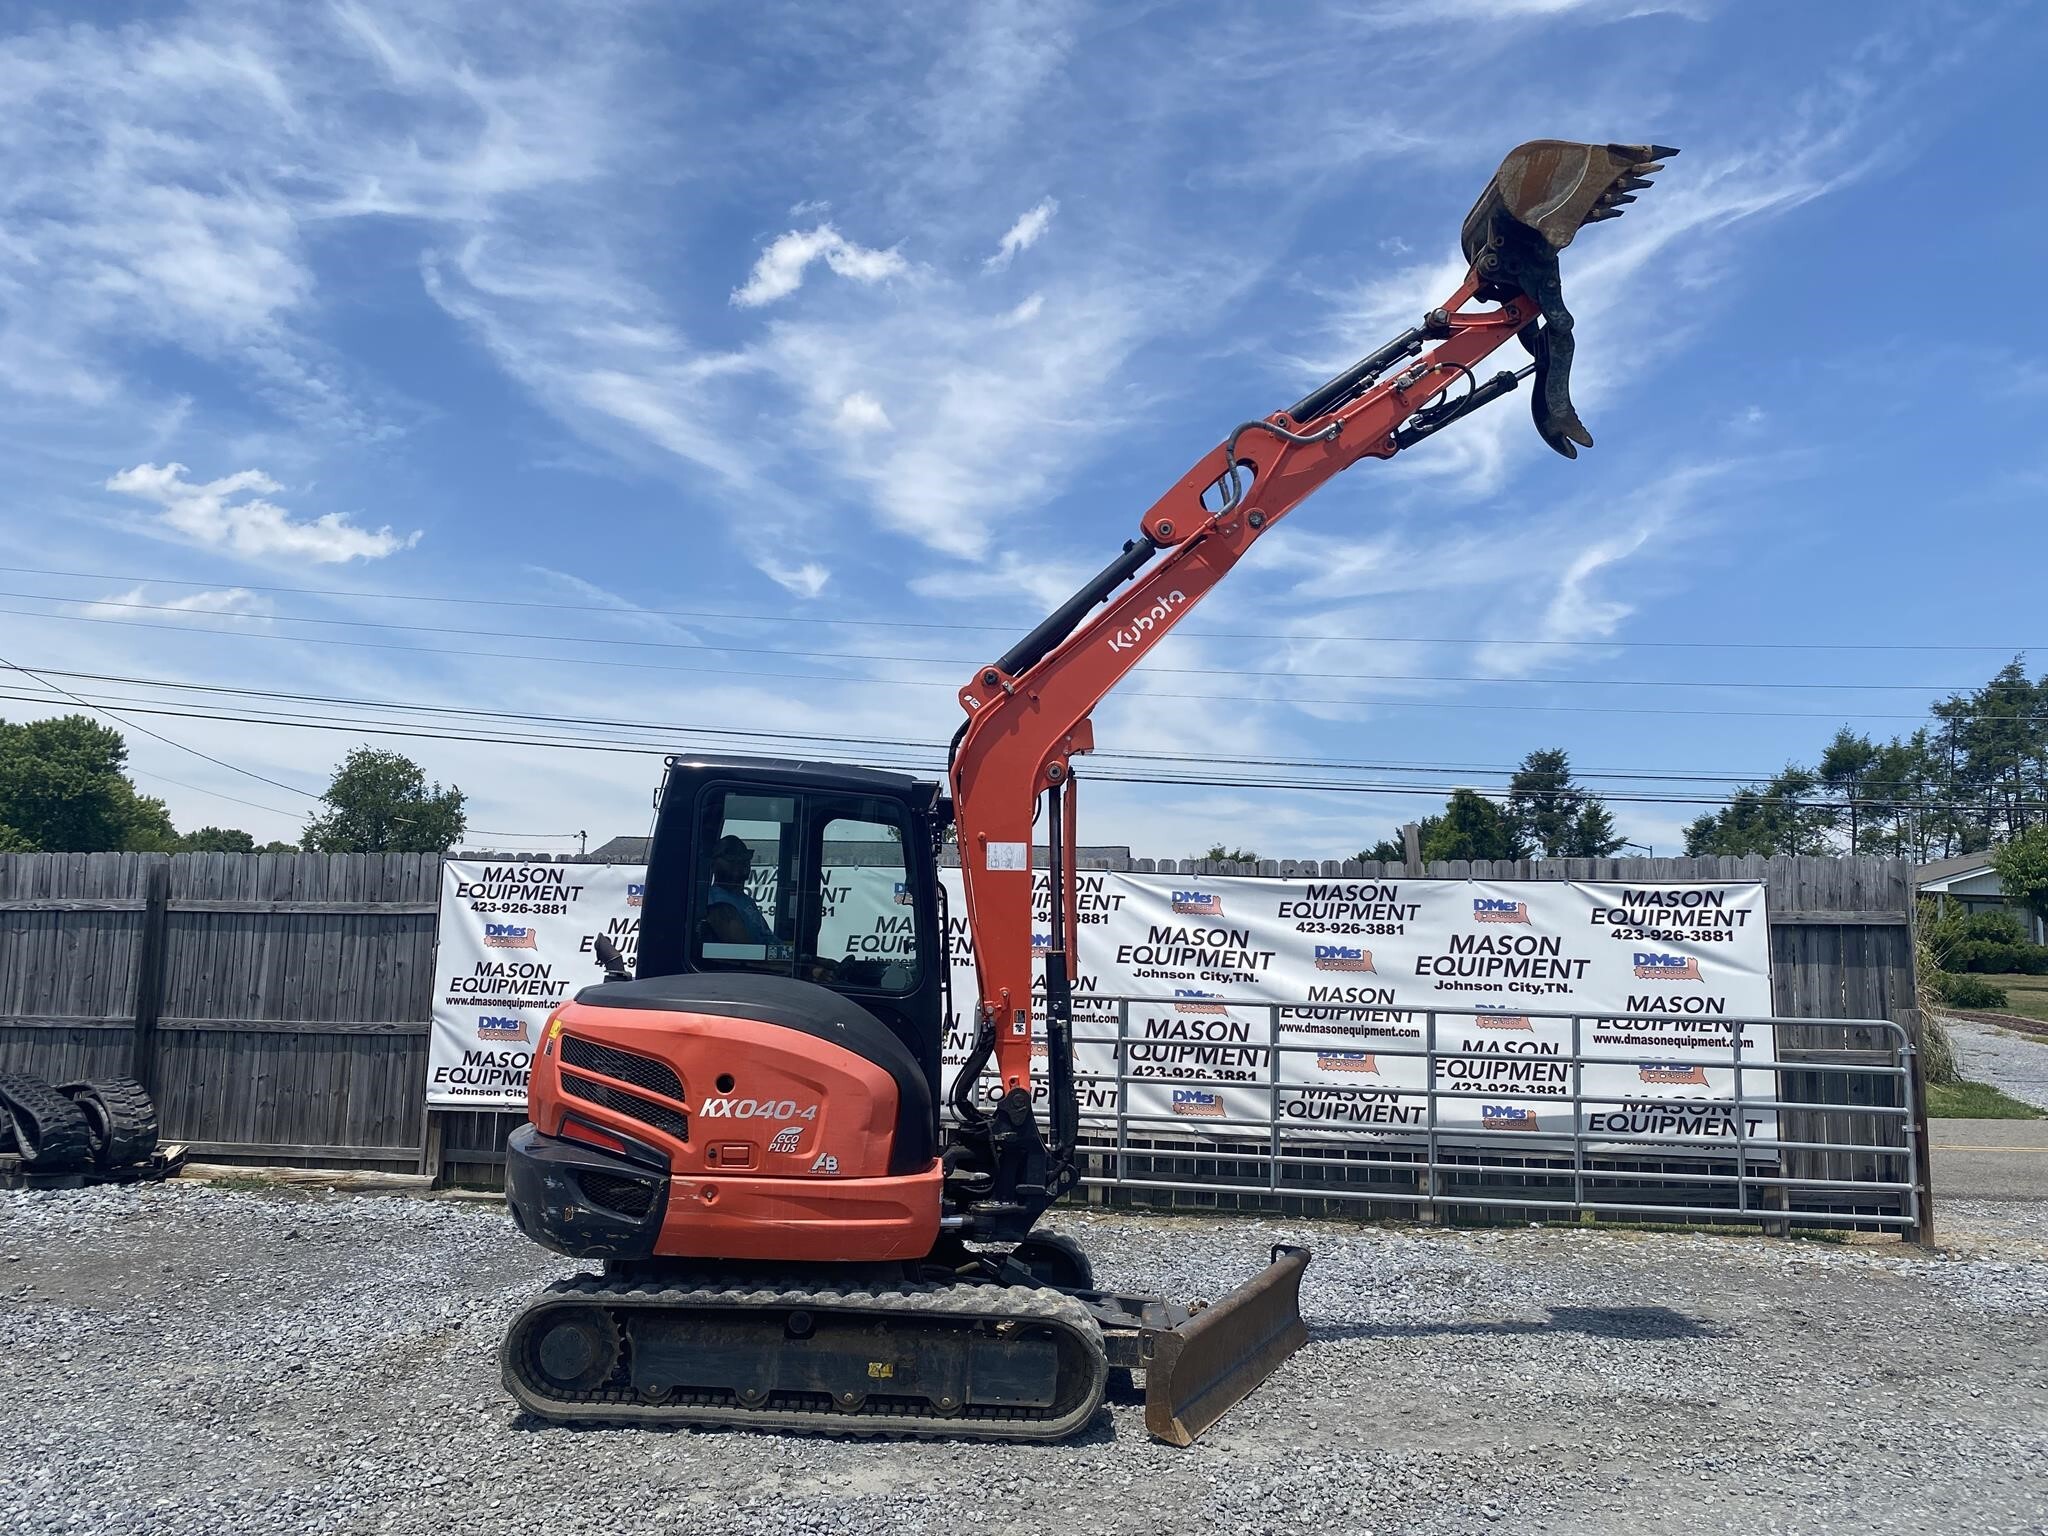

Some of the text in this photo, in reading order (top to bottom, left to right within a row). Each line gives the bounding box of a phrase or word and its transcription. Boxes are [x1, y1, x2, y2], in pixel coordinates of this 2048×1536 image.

[1107, 590, 1187, 653] Kubota
[482, 867, 565, 884] MASON
[456, 883, 583, 901] EQUIPMENT
[1306, 884, 1398, 902] MASON
[1622, 890, 1724, 908] MASON
[471, 902, 567, 915] 423-926-3881
[1278, 902, 1421, 921] EQUIPMENT
[1590, 908, 1752, 927] EQUIPMENT
[1148, 926, 1249, 949] MASON
[1296, 922, 1404, 936] 423-926-3881
[1611, 928, 1734, 942] 423-926-3881
[1449, 935, 1561, 957] MASON
[1116, 945, 1276, 970] EQUIPMENT
[475, 962, 552, 979] MASON
[1133, 968, 1195, 980] Johnson
[1415, 956, 1591, 979] EQUIPMENT
[450, 978, 570, 996] EQUIPMENT
[1308, 986, 1395, 1004] MASON
[1434, 980, 1503, 992] Johnson
[446, 995, 561, 1010] www.dmasonequipment.co
[1626, 995, 1725, 1014] MASON
[1145, 1019, 1250, 1042] MASON
[1279, 1022, 1420, 1038] www.dmasonequipment.com
[462, 1050, 533, 1068] MASO
[448, 1087, 500, 1097] Johnson
[699, 1098, 818, 1121] KX040-4
[1279, 1100, 1426, 1124] EQUIPMENT
[1588, 1113, 1763, 1138] EQUIPMENT
[768, 1143, 798, 1152] PLUS
[777, 1134, 800, 1144] eco
